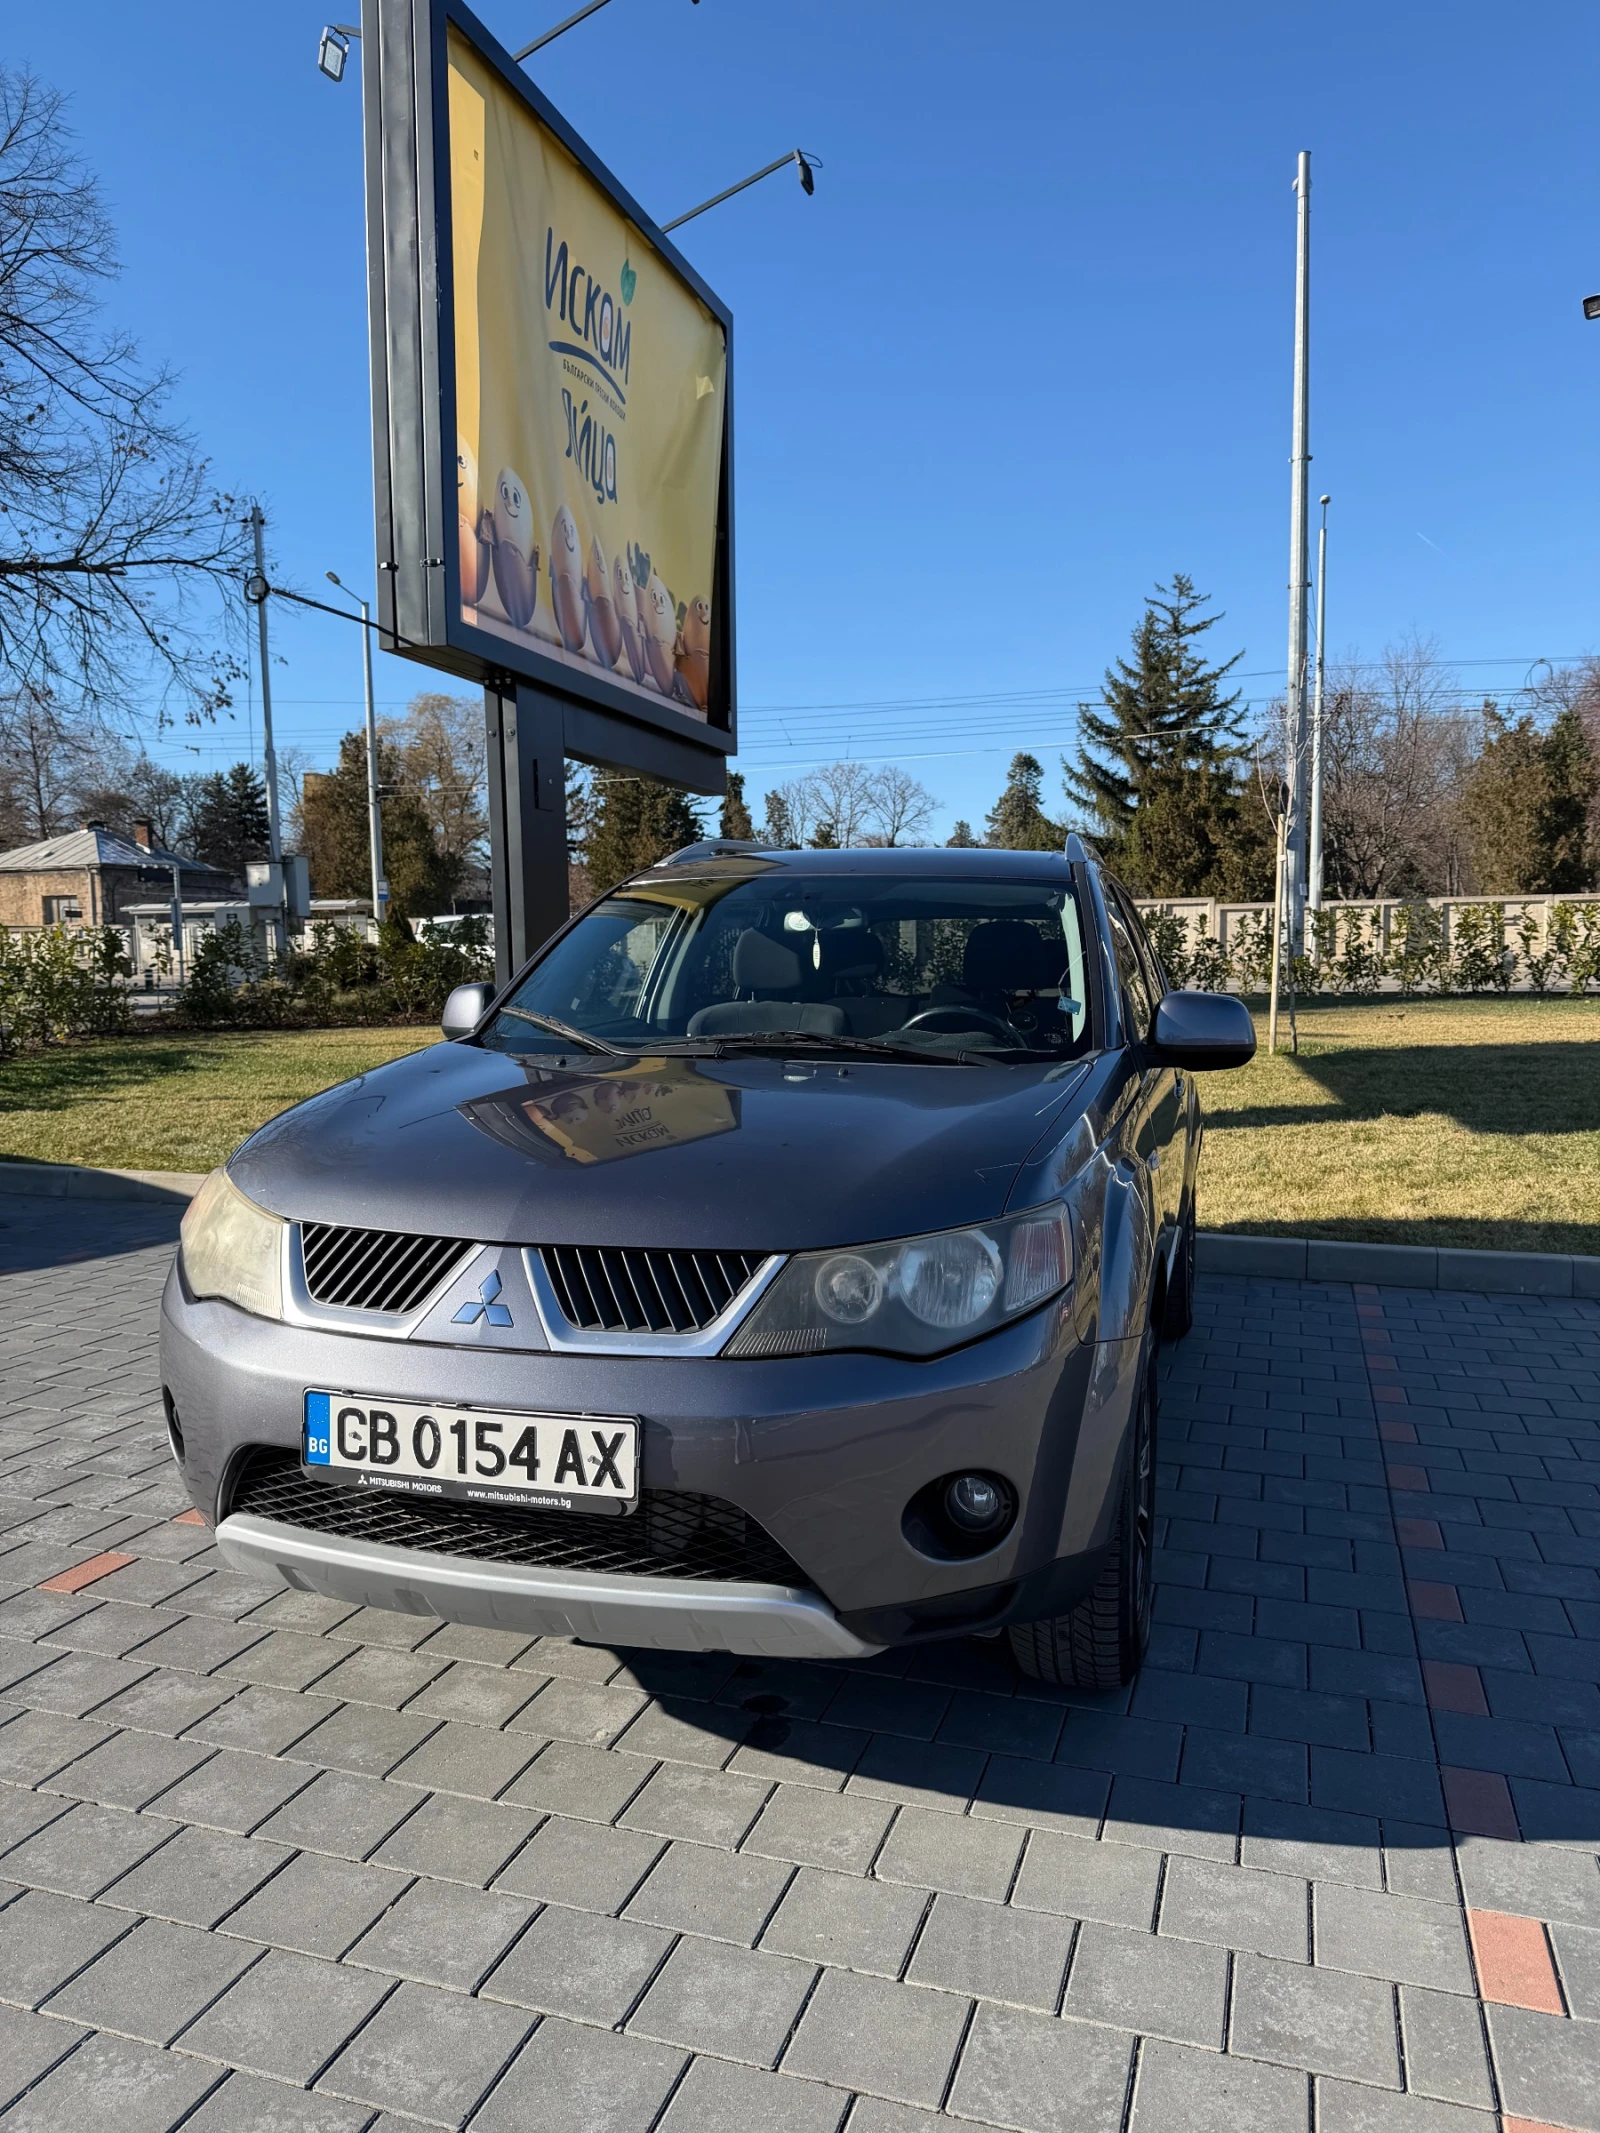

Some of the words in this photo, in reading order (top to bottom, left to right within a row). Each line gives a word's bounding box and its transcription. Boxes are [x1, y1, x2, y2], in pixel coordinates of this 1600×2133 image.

[563, 358, 594, 389] БЪЛГАРСКИ
[308, 1436, 328, 1454] BG
[337, 1406, 401, 1465] CB
[412, 1414, 541, 1482] 0154
[553, 1428, 627, 1490] AX
[369, 1476, 410, 1490] MITSUBISHI
[411, 1481, 443, 1493] MOTORS
[467, 1488, 572, 1509] www.mitsubishi-motors.bg
